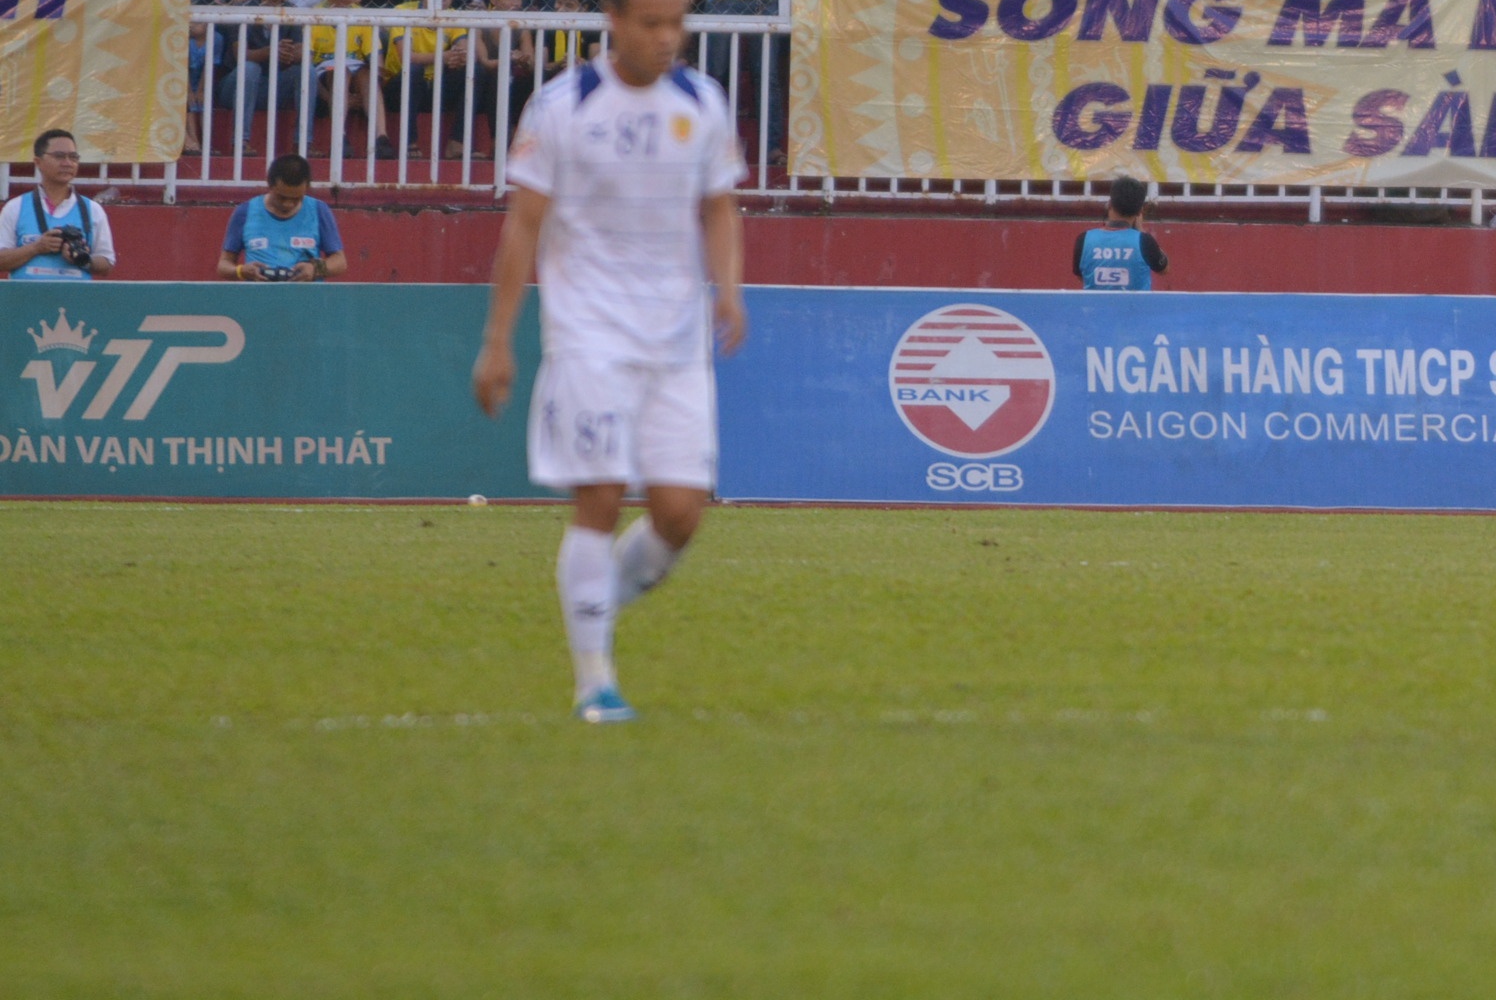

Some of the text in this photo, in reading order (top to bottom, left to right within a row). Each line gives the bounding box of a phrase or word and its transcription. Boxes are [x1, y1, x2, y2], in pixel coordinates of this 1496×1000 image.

[1051, 67, 1312, 154] GIỮA
[1093, 247, 1134, 260] 2017
[1097, 271, 1121, 283] LS
[1086, 334, 1207, 395] NGÂN
[1223, 334, 1343, 396] HÀNG
[1357, 348, 1474, 399] TMCP
[896, 388, 991, 403] BANK
[1088, 409, 1248, 441] SAIGON
[74, 435, 155, 472] VẠN
[162, 436, 283, 474] THỊNH
[294, 430, 393, 466] PHÁT
[926, 462, 1023, 491] SCB
